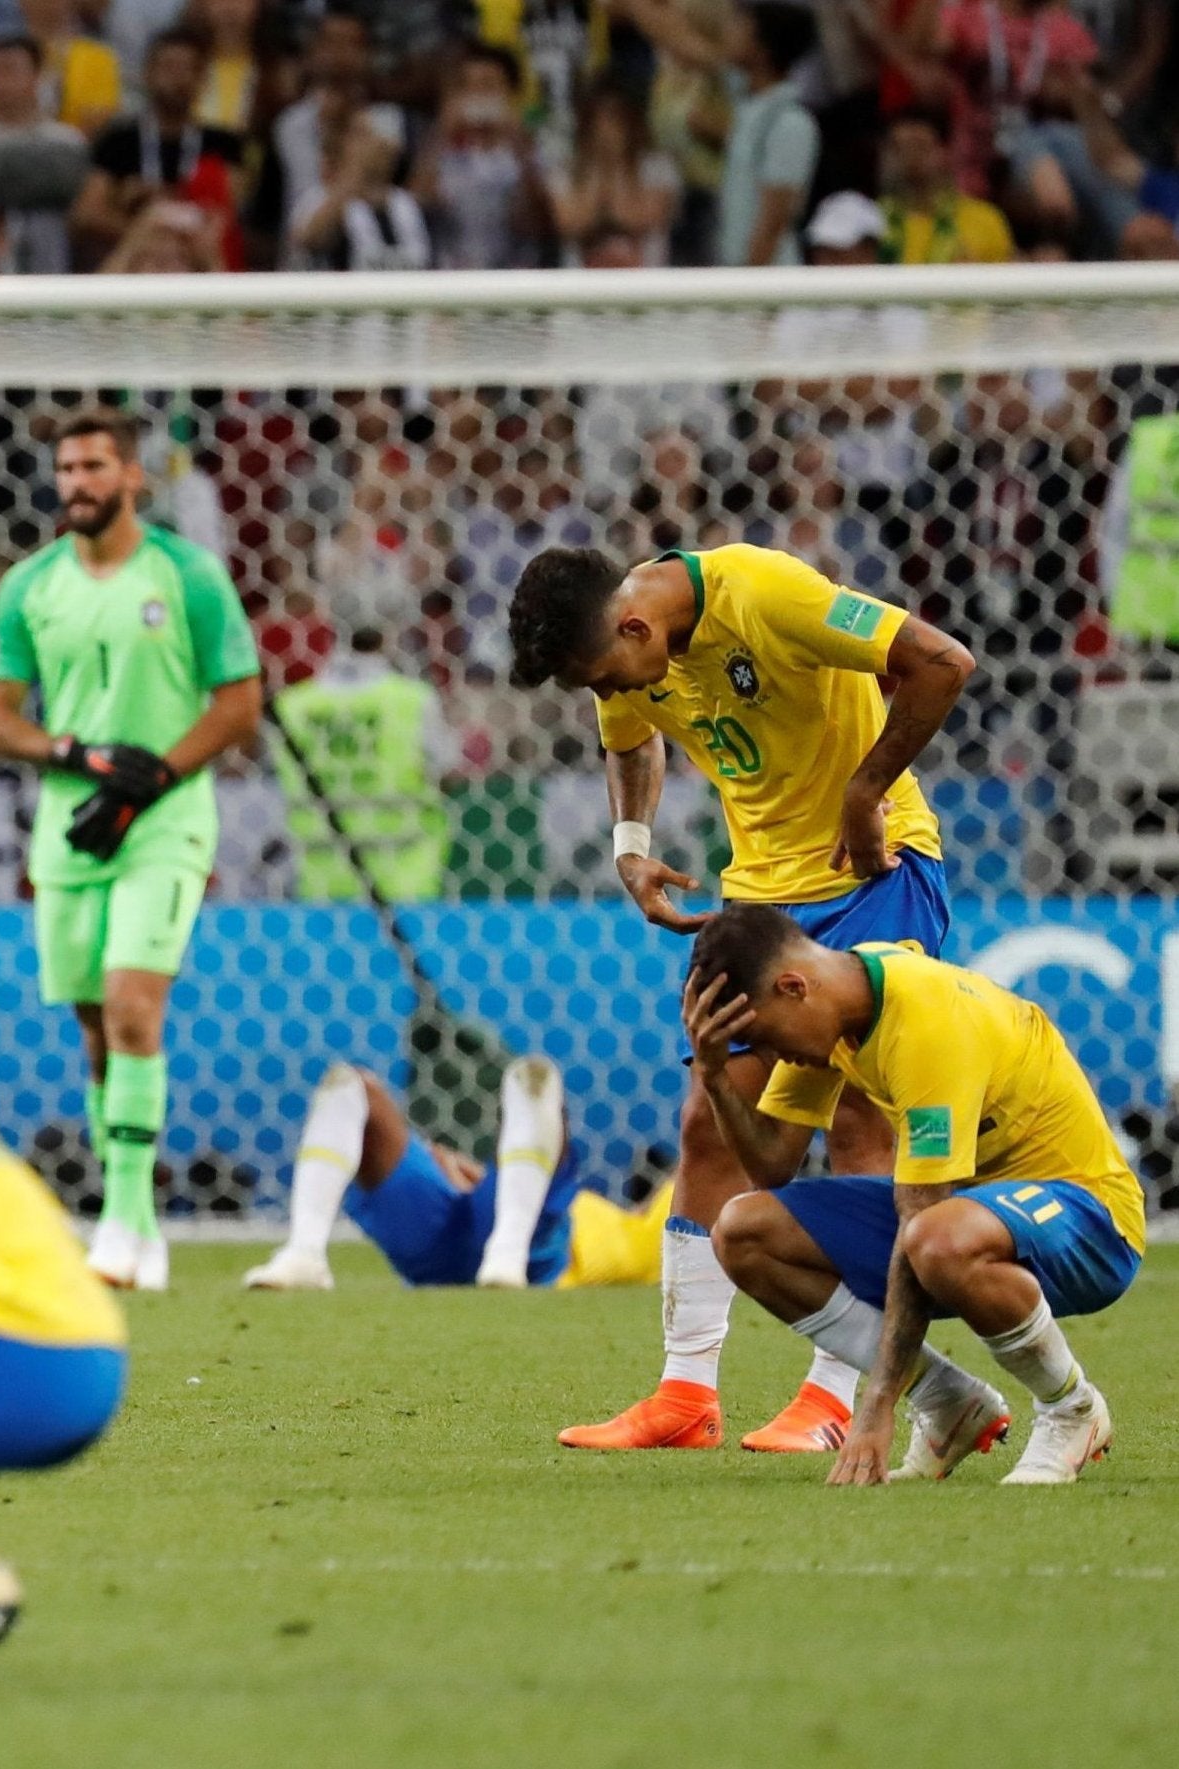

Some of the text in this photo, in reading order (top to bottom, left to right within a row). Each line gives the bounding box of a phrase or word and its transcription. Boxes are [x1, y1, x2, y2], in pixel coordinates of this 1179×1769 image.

[98, 642, 109, 689] 1
[692, 717, 761, 776] 20
[168, 881, 182, 924] 1
[1013, 1185, 1064, 1225] 11
